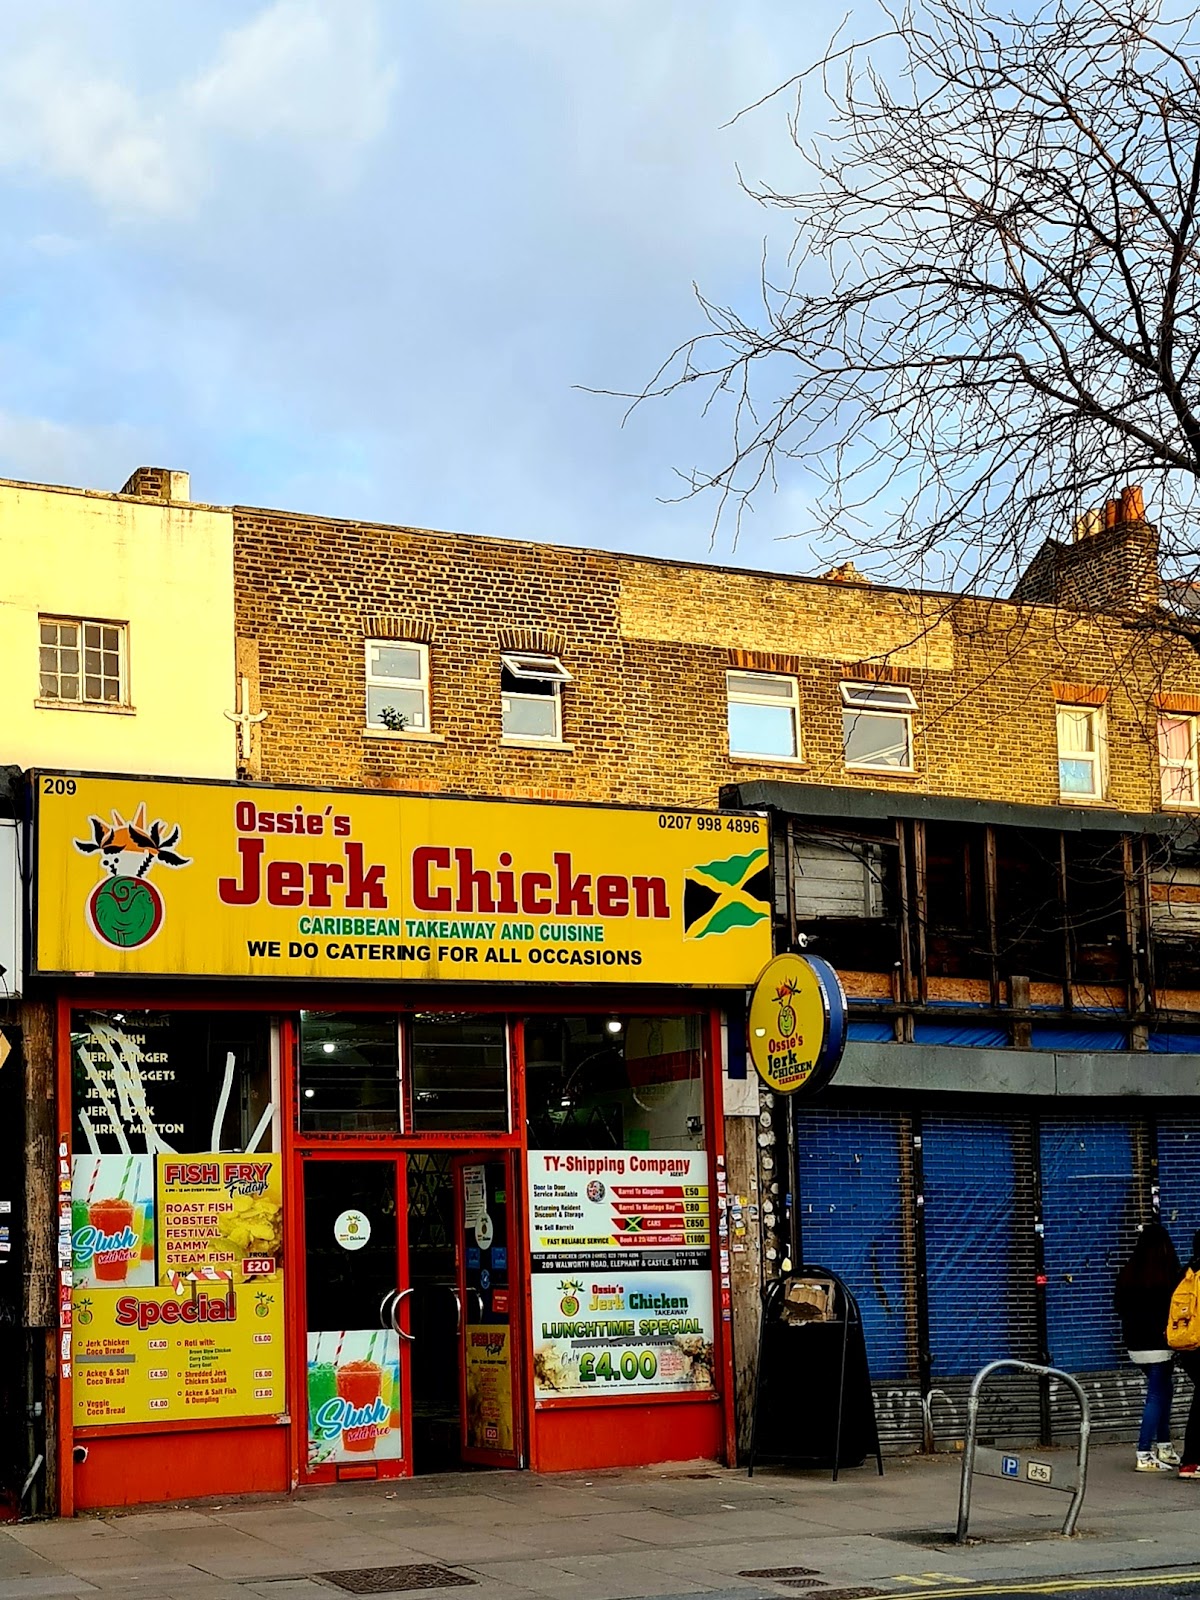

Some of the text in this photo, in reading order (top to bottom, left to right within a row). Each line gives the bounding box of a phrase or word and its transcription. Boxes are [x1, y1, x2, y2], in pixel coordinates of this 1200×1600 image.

[43, 778, 77, 796] 209
[235, 800, 351, 837] Ossie's
[658, 814, 760, 835] 0207 998 4896
[218, 837, 670, 919] Jerk Chicken
[299, 916, 604, 942] CARIBBEAN TAKEAWAY AND CUISINE
[247, 940, 643, 967] WE DO CATERING FOR ALL OCCASIONS
[84, 1034, 115, 1044] JEK
[768, 1033, 804, 1054] Ossie's
[119, 1052, 169, 1063] BRGER
[767, 1049, 798, 1076] Jerk
[85, 1070, 176, 1080] JRK GGETS
[772, 1060, 813, 1080] CHICKEN
[778, 1072, 807, 1086] TAKEAWAY
[85, 1088, 116, 1099] JEK
[120, 1106, 155, 1117] OK
[86, 1123, 125, 1134] URRY
[543, 1156, 691, 1175] TY-Shipping Company
[165, 1162, 273, 1185] FISH FRY
[686, 1188, 699, 1196] £50
[166, 1202, 234, 1213] ROAST FISH
[666, 1204, 676, 1212] Bay
[686, 1204, 700, 1212] £80
[166, 1216, 218, 1226] LOBSTER
[686, 1220, 704, 1228] £850
[166, 1228, 221, 1238] FESTIVAL
[72, 1225, 139, 1263] Slush
[166, 1241, 209, 1250] BAMMY
[166, 1252, 234, 1264] STEAM FISH
[555, 1260, 589, 1268] WALWORTH
[610, 1260, 640, 1268] ELEPHANT
[672, 1258, 687, 1266] SE17
[247, 1260, 271, 1272] £20
[592, 1284, 624, 1294] Ossie's
[589, 1293, 689, 1312] Jerk Chicken
[115, 1292, 237, 1330] Special
[542, 1318, 703, 1339] LUNCHTIME SPECIAL
[86, 1338, 130, 1348] Jerk Chicken
[200, 1338, 216, 1346] with:
[105, 1346, 125, 1354] Bread
[579, 1350, 657, 1382] £4.00
[86, 1368, 130, 1377] Ackee & Salt
[150, 1370, 168, 1378] £4.50
[86, 1376, 125, 1386] Coco Bread
[86, 1400, 110, 1408] Veggie
[192, 1396, 219, 1404] Dumpling
[86, 1406, 126, 1416] Coco Bread
[316, 1396, 391, 1440] Slush
[1006, 1458, 1016, 1472] P
